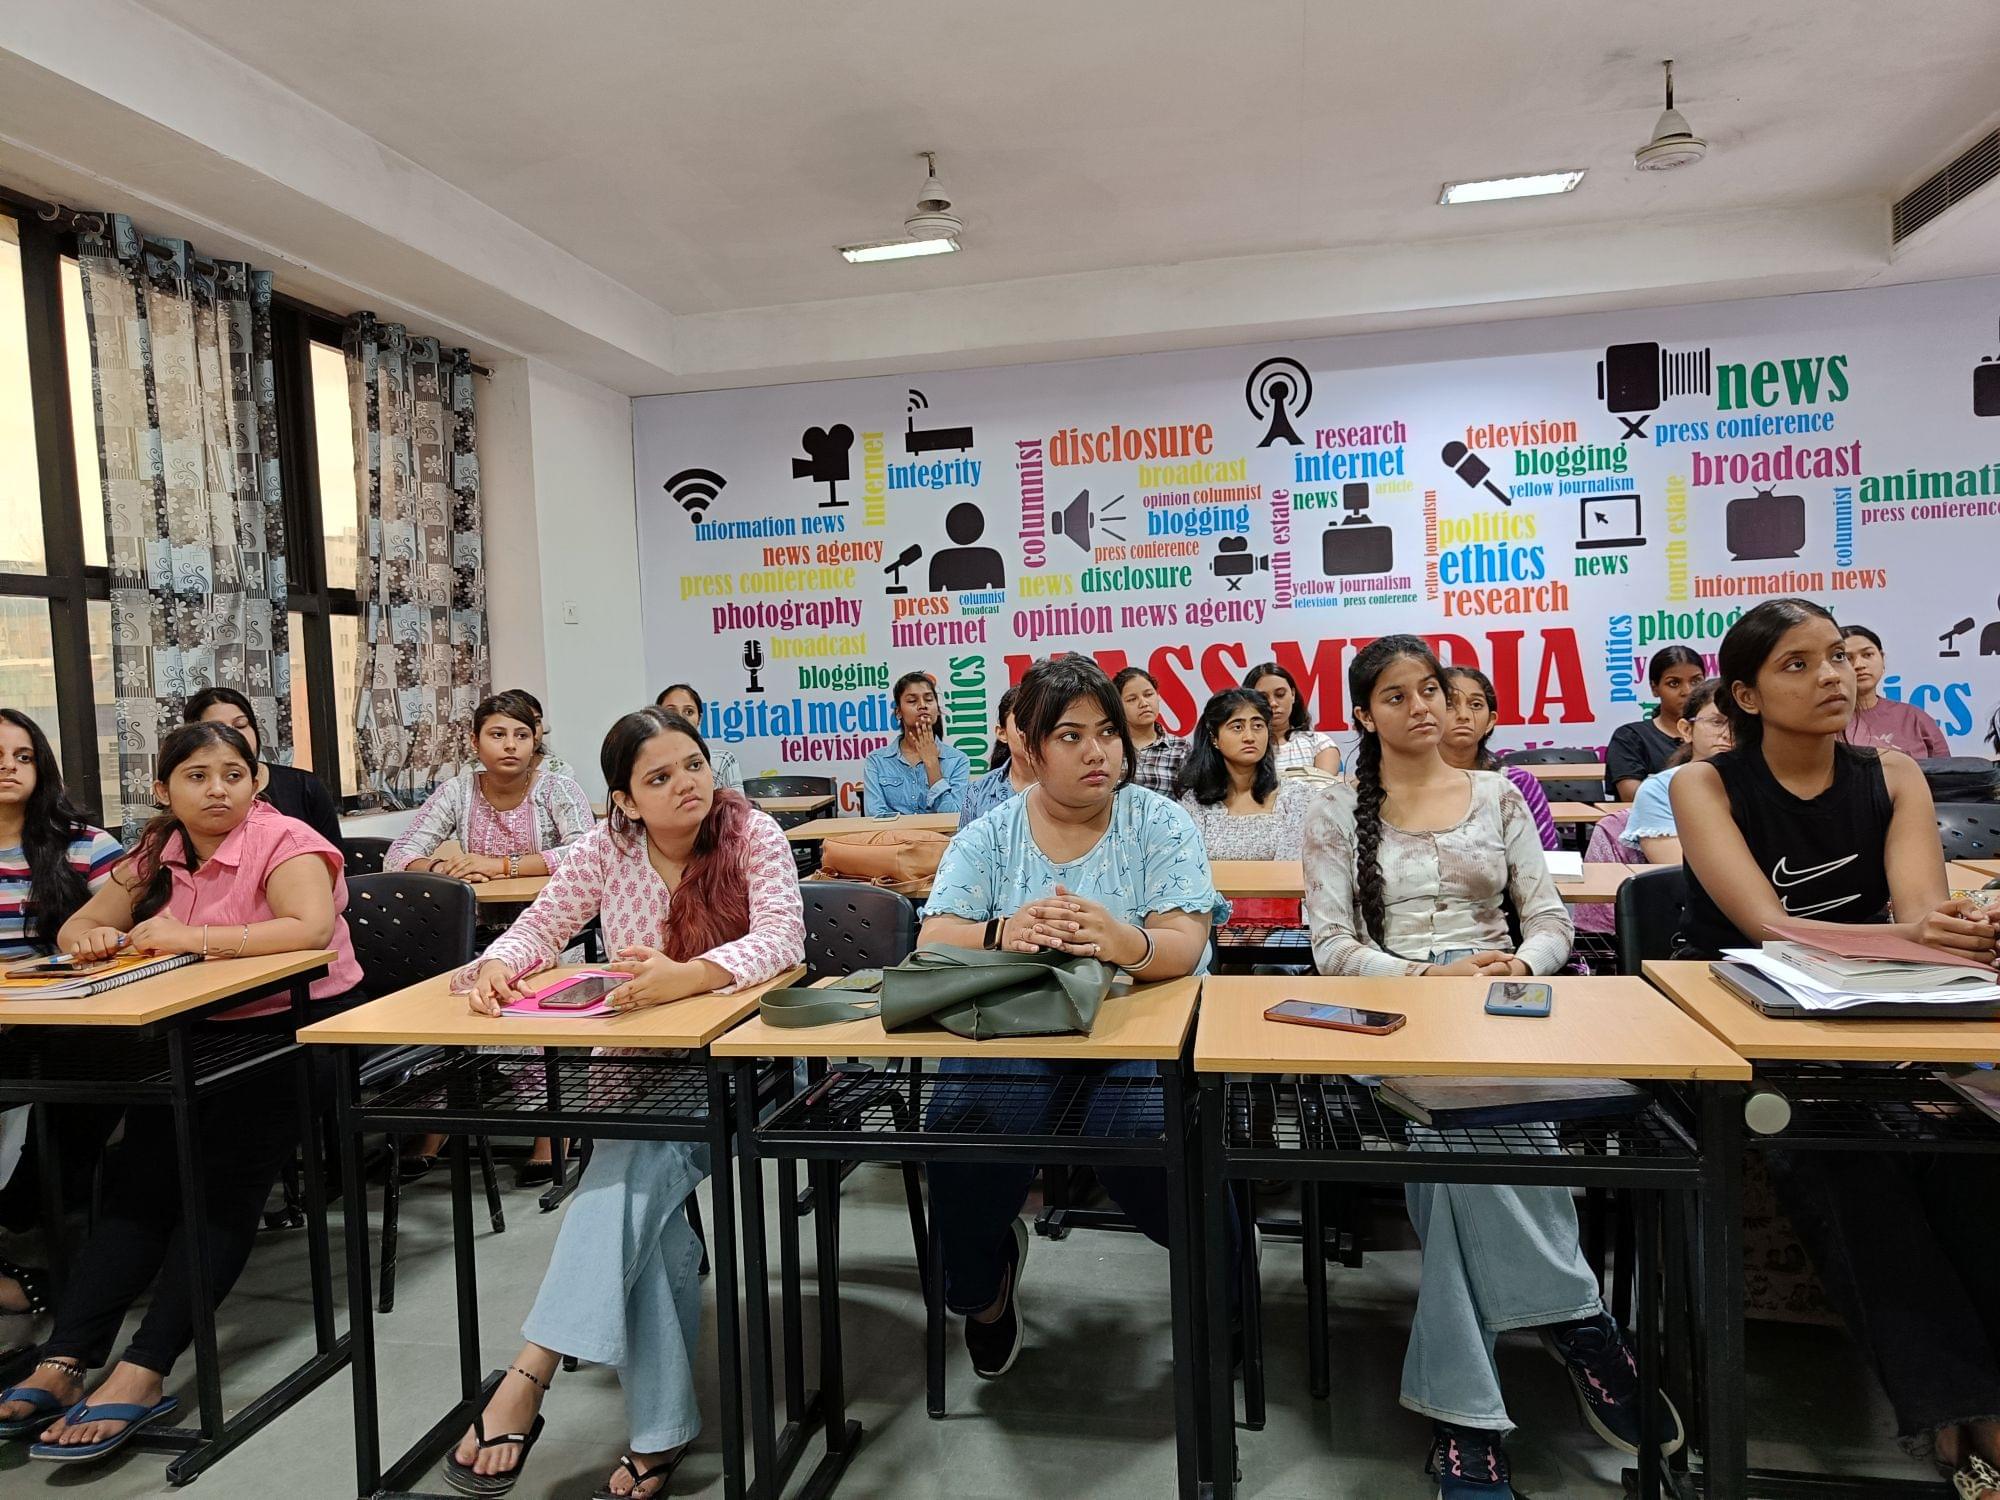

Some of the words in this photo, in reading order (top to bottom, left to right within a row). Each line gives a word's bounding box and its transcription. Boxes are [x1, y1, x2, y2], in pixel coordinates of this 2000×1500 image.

[1716, 354, 1848, 411] news
[1050, 424, 1212, 466] disclosure
[1316, 421, 1408, 449] research
[1466, 421, 1578, 449] television
[1654, 422, 1709, 447] press
[1715, 413, 1835, 439] conference
[888, 458, 981, 489] integrity
[1139, 458, 1246, 488] broadcast
[1295, 447, 1403, 483] internet
[1515, 443, 1628, 477] blogging
[1692, 440, 1861, 487] broadcast
[861, 431, 886, 526] internet
[1509, 482, 1553, 498] yellow
[1559, 477, 1636, 496] journalism
[1015, 439, 1046, 568] columnist
[1143, 492, 1190, 508] opinion
[1193, 484, 1262, 504] columnist
[1293, 491, 1338, 510] news
[1666, 476, 1687, 535] estate
[695, 518, 797, 542] information
[801, 514, 846, 535] news
[1148, 505, 1252, 537] blogging
[1270, 489, 1291, 545] estate
[1423, 490, 1439, 556] journalism
[1834, 487, 1854, 567] columnist
[1861, 508, 1905, 525] press
[1910, 501, 2000, 520] conferenc
[1438, 511, 1536, 549] politics
[764, 546, 810, 566] news
[816, 541, 882, 566] agency
[1095, 546, 1127, 563] press
[1130, 541, 1199, 558] conference
[1440, 543, 1545, 585] ethics
[1575, 556, 1629, 576] news
[680, 574, 733, 600] press
[739, 567, 855, 593] conference
[1019, 575, 1073, 598] news
[1080, 566, 1192, 593] disclosure
[1270, 551, 1292, 609] fourth
[1293, 578, 1334, 598] yellow
[1339, 575, 1412, 594] journalism
[1424, 561, 1439, 601] yellow
[1665, 540, 1688, 602] fourth
[1694, 571, 1824, 598] information
[1832, 570, 1886, 590] news
[894, 597, 949, 621] press
[959, 592, 1006, 606] columnist
[961, 605, 1001, 617] broadcast
[1295, 597, 1338, 608] television
[1344, 597, 1366, 607] press
[1368, 594, 1418, 605] conference
[1444, 581, 1568, 617] research
[713, 597, 861, 634] photography
[1013, 603, 1113, 641] opinion
[1121, 603, 1178, 628] news
[1185, 598, 1266, 627] agency
[771, 633, 867, 659] broadcast
[892, 616, 986, 647] internet
[1606, 614, 1638, 703] politics
[799, 663, 890, 690] blogging
[1005, 643, 1247, 737] SS
[1272, 628, 1594, 731] MIA
